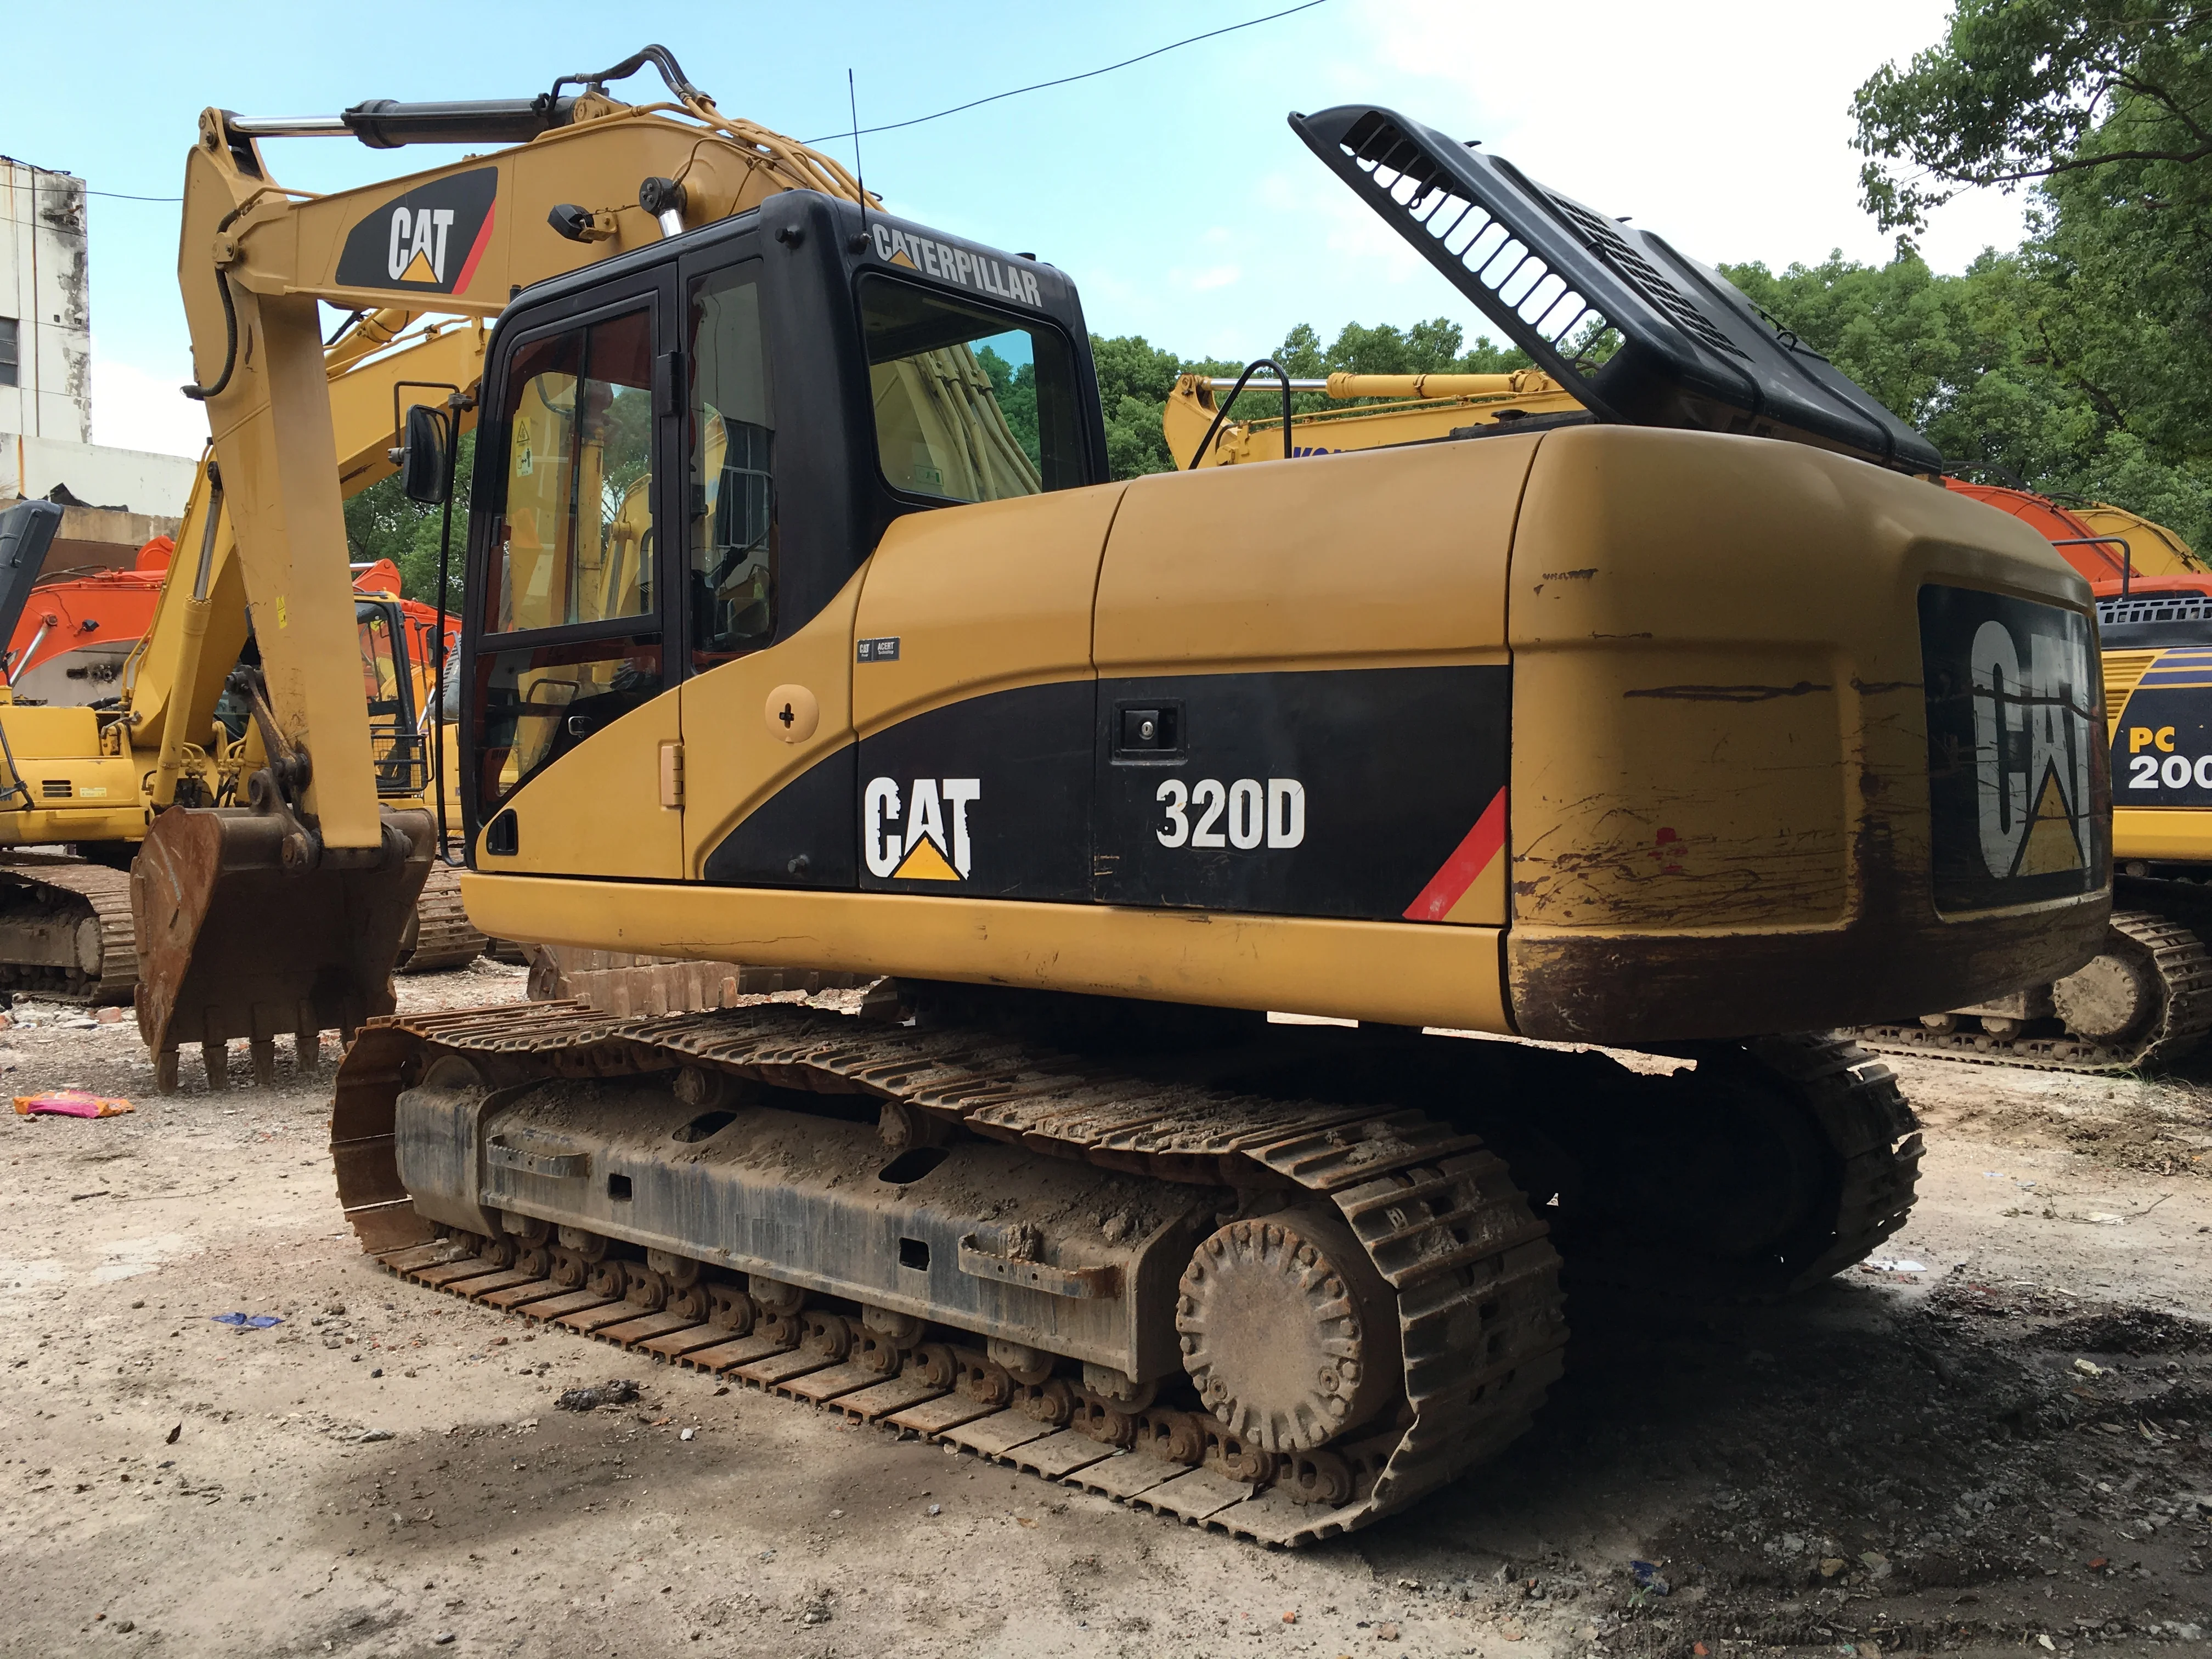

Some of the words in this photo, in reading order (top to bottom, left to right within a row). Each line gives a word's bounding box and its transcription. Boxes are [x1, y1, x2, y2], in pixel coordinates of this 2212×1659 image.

[388, 207, 454, 283] CAT
[872, 223, 1042, 307] CATERPILLAR
[859, 644, 870, 653] CAT
[878, 642, 895, 651] ACERT
[1971, 620, 2091, 878] CAT
[2129, 755, 2212, 788] 200
[2130, 726, 2175, 753] PC
[865, 777, 980, 880] CAT
[1156, 778, 1305, 850] 320D
